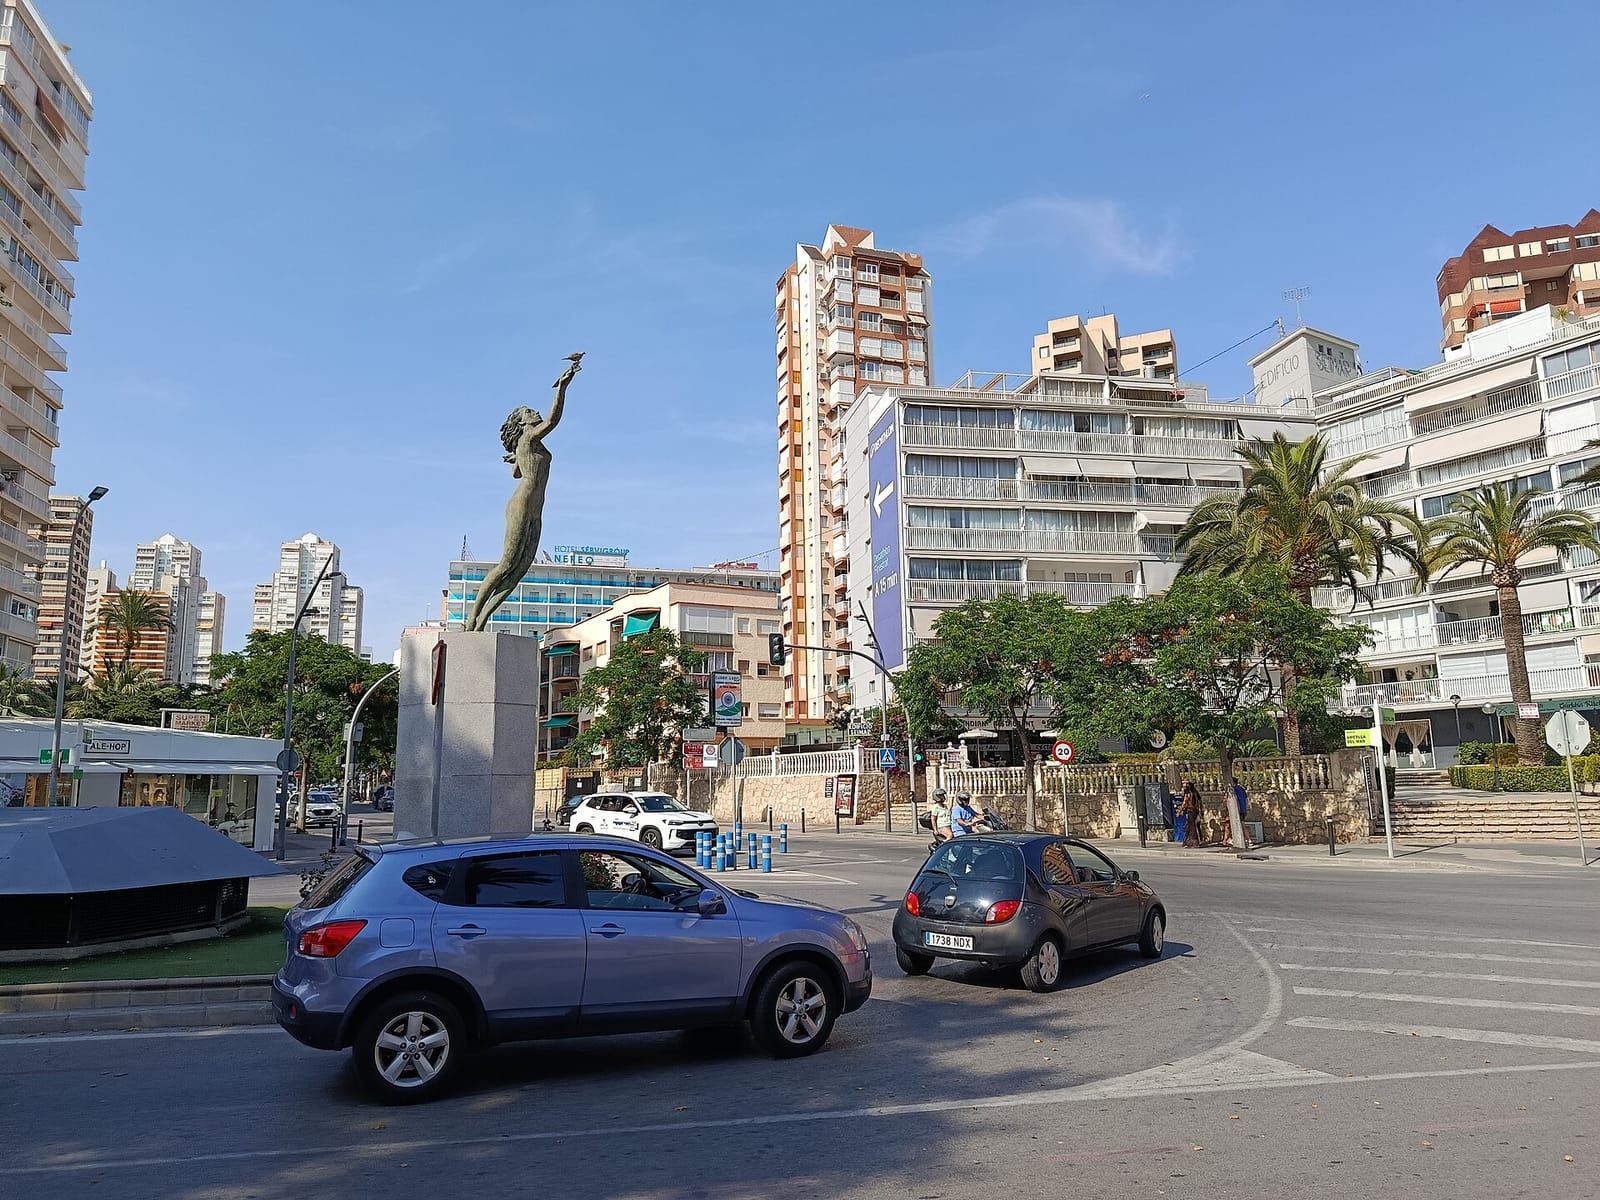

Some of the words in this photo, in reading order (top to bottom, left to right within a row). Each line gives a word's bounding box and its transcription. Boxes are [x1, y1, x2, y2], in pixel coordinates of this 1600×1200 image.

[1261, 354, 1300, 389] EDIFICIO
[554, 545, 578, 553] HOTEL
[874, 581, 880, 598] A
[880, 576, 887, 594] 15
[887, 569, 898, 590] min
[1058, 748, 1070, 756] 20
[931, 934, 951, 946] 1738
[953, 937, 971, 948] NDX
